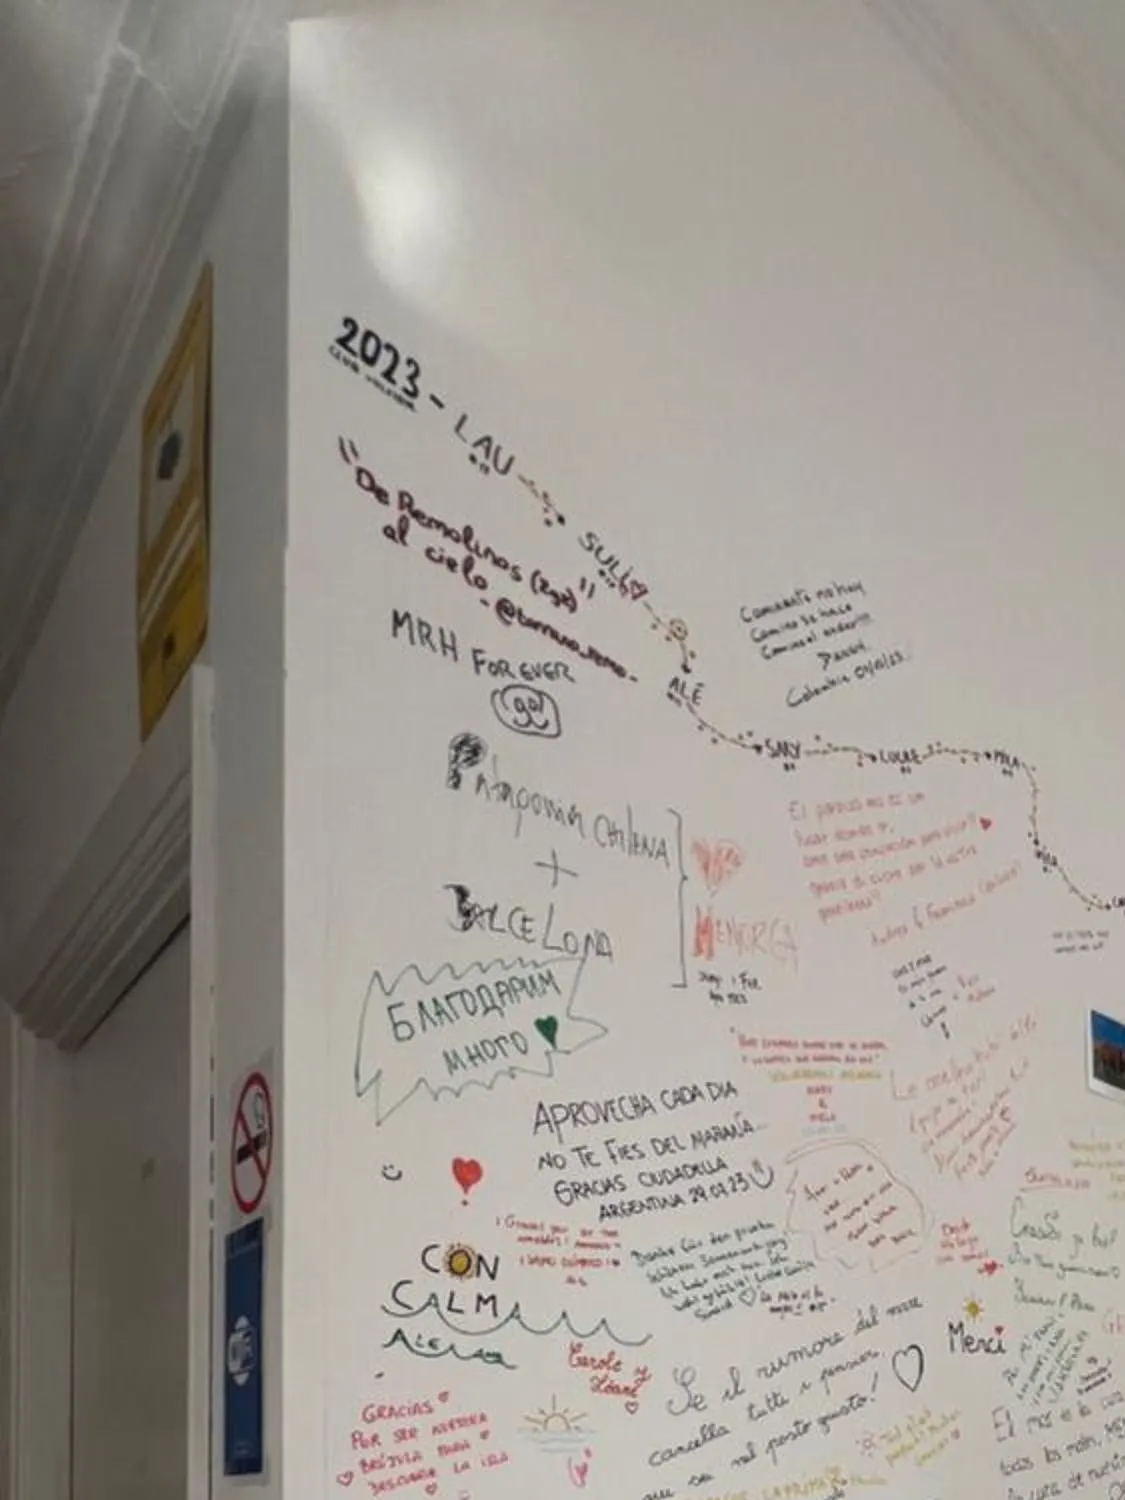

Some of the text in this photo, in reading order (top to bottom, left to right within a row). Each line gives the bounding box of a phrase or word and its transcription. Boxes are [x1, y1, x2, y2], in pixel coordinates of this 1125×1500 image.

[336, 316, 420, 399] 2023
[454, 413, 515, 475] LAU
[383, 518, 489, 591] al cielo
[398, 490, 523, 583] Remolinos
[391, 609, 458, 661] MRH
[387, 971, 562, 1042] БЛАГОДАРИМ
[443, 1031, 528, 1075] МНОГО
[533, 1099, 656, 1143] APROVECHA
[659, 1084, 703, 1110] CADA
[537, 1150, 567, 1170] NO
[650, 1135, 684, 1157] DEL
[553, 1174, 627, 1207] GRACIAS
[599, 1193, 688, 1223] ARGENTINA
[421, 1244, 500, 1281] CON
[757, 1332, 845, 1380] rumore
[947, 1319, 1008, 1356] Merci
[361, 1400, 434, 1424] GRACIAS
[350, 1430, 382, 1450] POR
[393, 1427, 418, 1443] SER
[648, 1423, 731, 1467] cancella
